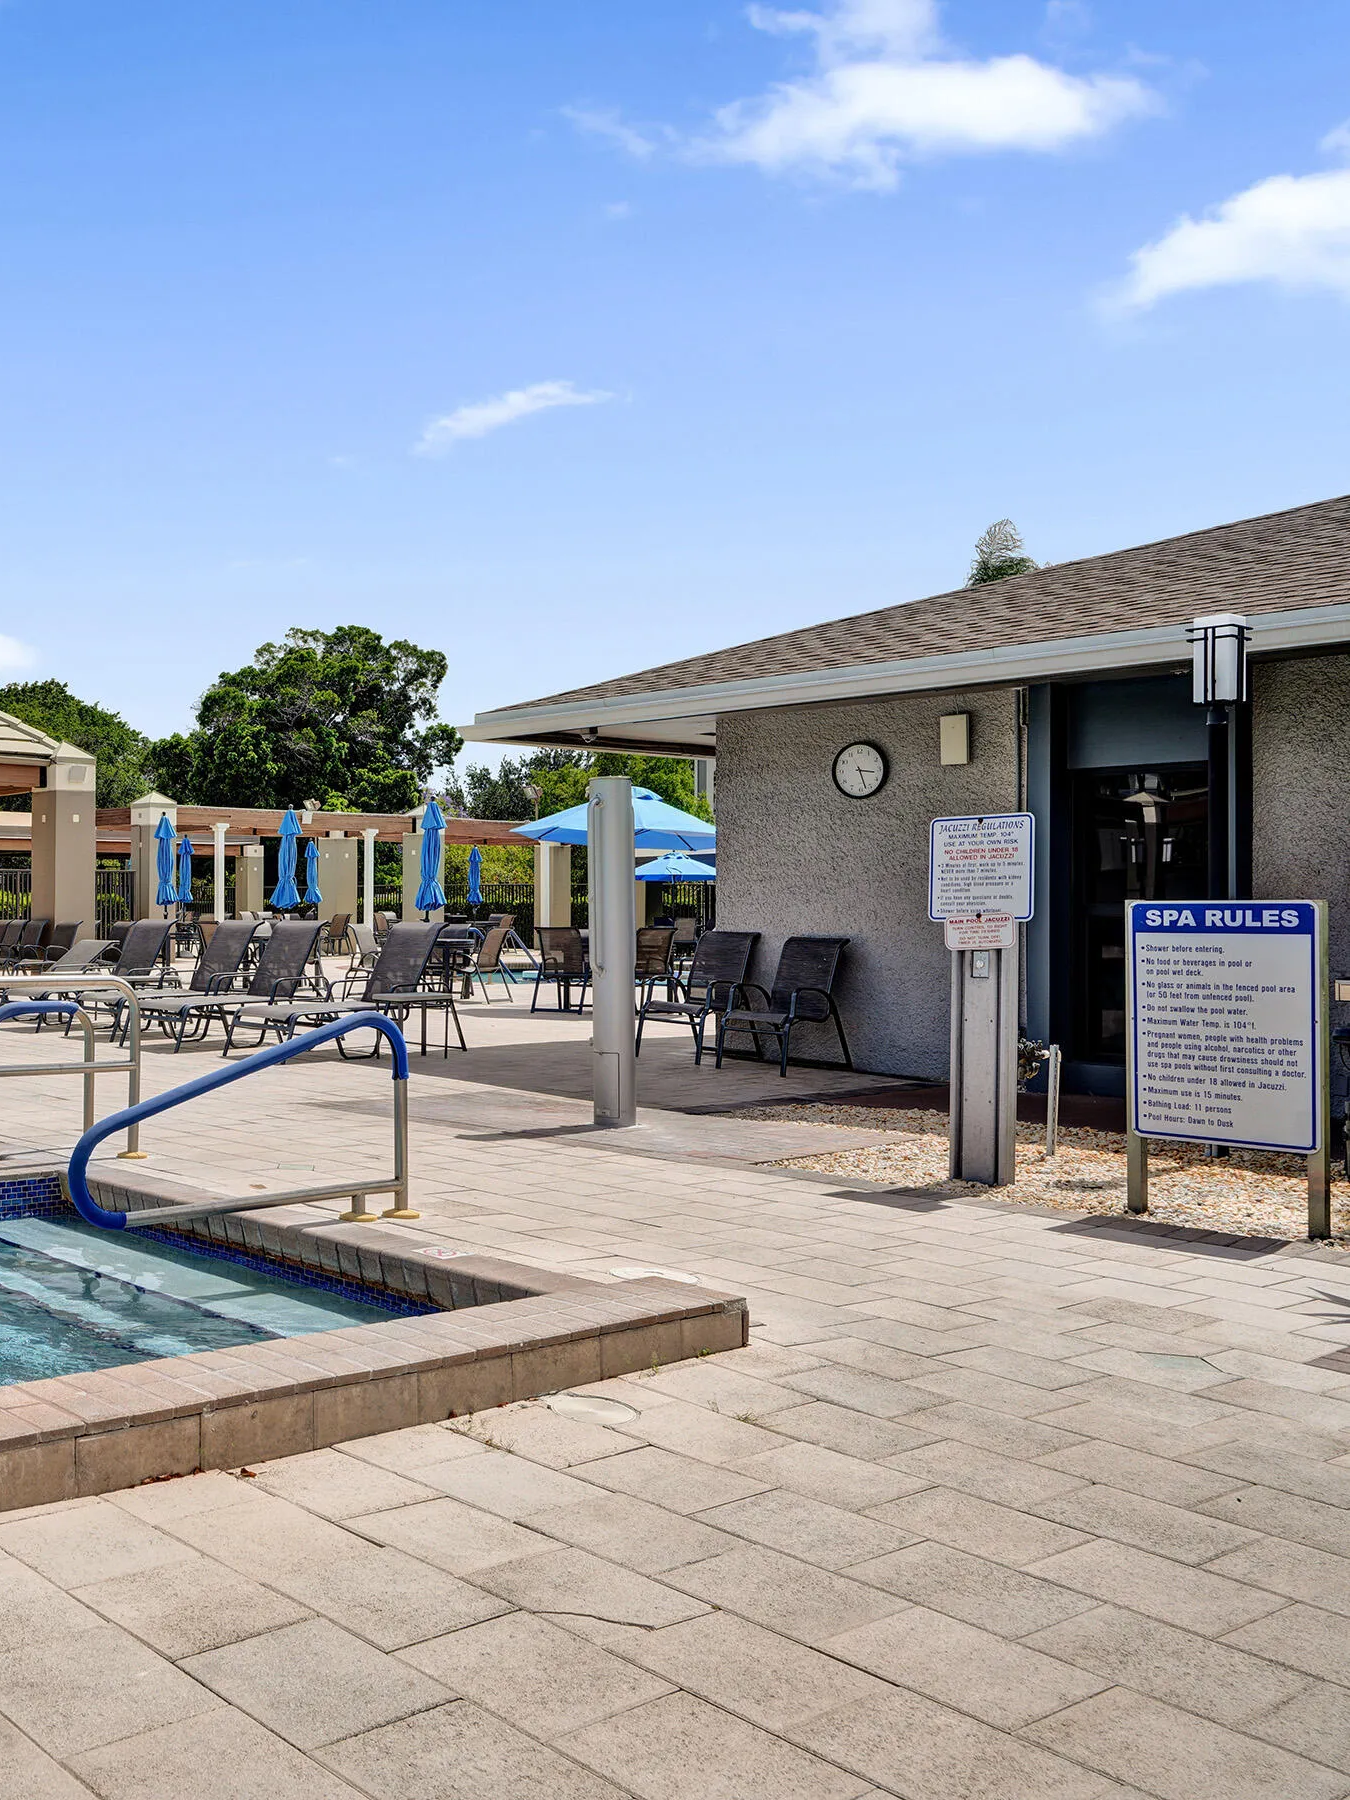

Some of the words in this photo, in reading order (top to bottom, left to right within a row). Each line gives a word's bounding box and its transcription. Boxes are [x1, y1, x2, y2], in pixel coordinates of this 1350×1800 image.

[939, 823, 969, 834] JACUZZI
[972, 820, 1024, 831] REGULATIONS
[1145, 910, 1197, 926] SPA
[1205, 910, 1299, 927] RULES
[1195, 946, 1225, 954] entering.
[1183, 959, 1216, 967] beverages
[1219, 959, 1225, 967] in
[1228, 960, 1242, 968] pool
[1186, 982, 1211, 990] animals
[1236, 984, 1258, 992] fenced
[1262, 985, 1276, 993] pool
[1147, 991, 1156, 999] (or
[1202, 993, 1232, 1001] unfenced
[1170, 1005, 1195, 1013] swallow
[1227, 1008, 1248, 1016] water.
[1147, 1017, 1177, 1026] Maximum
[1180, 1019, 1199, 1027] Water
[1202, 1020, 1221, 1029] Temp.
[1147, 1030, 1175, 1039] Pregnant
[1178, 1033, 1202, 1041] women,
[1246, 1036, 1267, 1044] health
[1270, 1038, 1304, 1046] problems
[1161, 1042, 1182, 1050] people
[1184, 1043, 1201, 1051] using
[1204, 1044, 1230, 1053] alcohol,
[1233, 1046, 1265, 1054] narcotics
[1147, 1050, 1165, 1059] drugs
[1182, 1053, 1195, 1061] may
[1198, 1054, 1217, 1062] cause
[1220, 1055, 1258, 1064] drowsiness
[1261, 1058, 1283, 1066] should
[1194, 1064, 1217, 1072] without
[1220, 1065, 1234, 1073] first
[1237, 1067, 1272, 1077] consulting
[1282, 1069, 1307, 1078] doctor.
[1148, 1073, 1156, 1081] No
[1159, 1074, 1185, 1083] children
[1220, 1079, 1246, 1088] allowed
[1258, 1081, 1287, 1091] Jacuzzi.
[1148, 1087, 1178, 1095] Maximum
[1195, 1090, 1201, 1098] is
[1214, 1092, 1242, 1101] minutes.
[1148, 1100, 1171, 1109] Bathing
[1205, 1105, 1232, 1114] persons
[1148, 1113, 1162, 1121] Pool
[1164, 1115, 1185, 1123] Hours:
[1188, 1117, 1205, 1125] Dawn
[1208, 1118, 1214, 1126] to
[1217, 1119, 1233, 1128] Dusk
